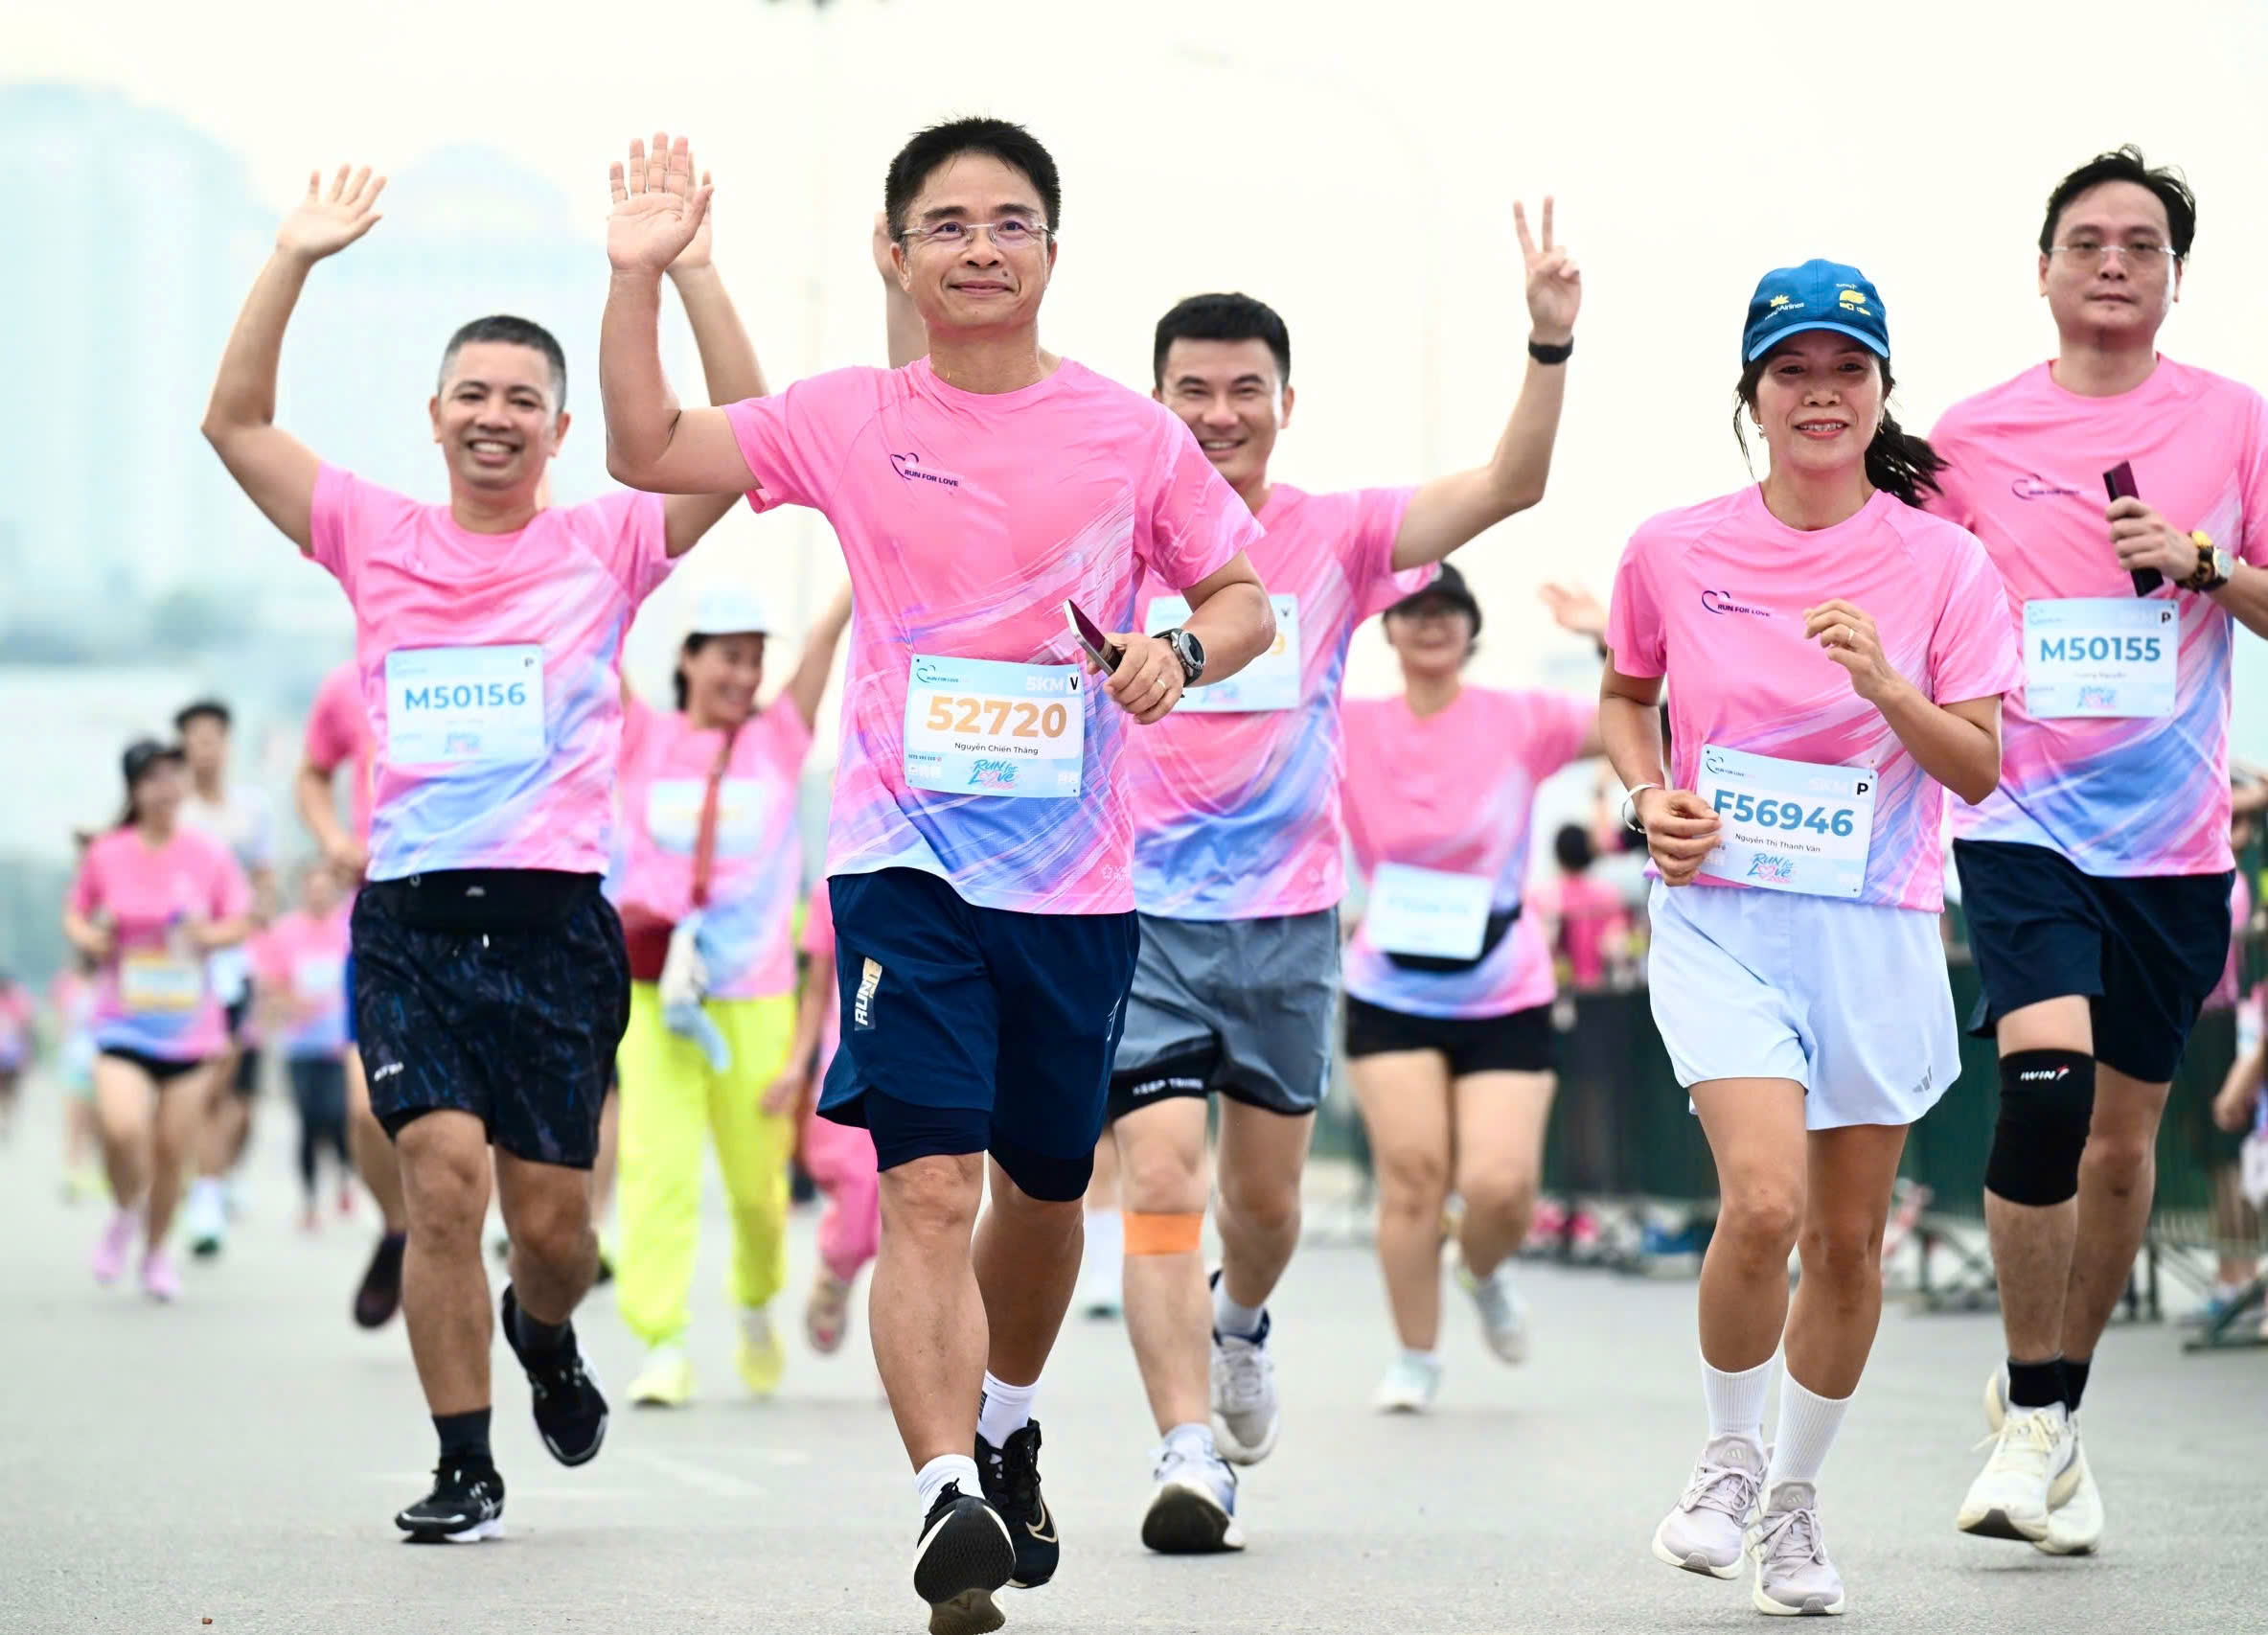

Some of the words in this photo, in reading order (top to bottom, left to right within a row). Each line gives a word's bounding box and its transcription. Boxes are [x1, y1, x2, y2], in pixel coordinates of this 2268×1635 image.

[905, 469, 921, 478] RUN
[922, 473, 937, 482] FOR
[939, 477, 958, 487] LOVE
[2161, 611, 2171, 623] P
[2040, 636, 2161, 662] M50155
[1068, 676, 1079, 691] V
[404, 681, 526, 711] M50156
[927, 696, 1067, 738] 52720
[1856, 782, 1869, 795] P
[1713, 789, 1855, 837] F56946
